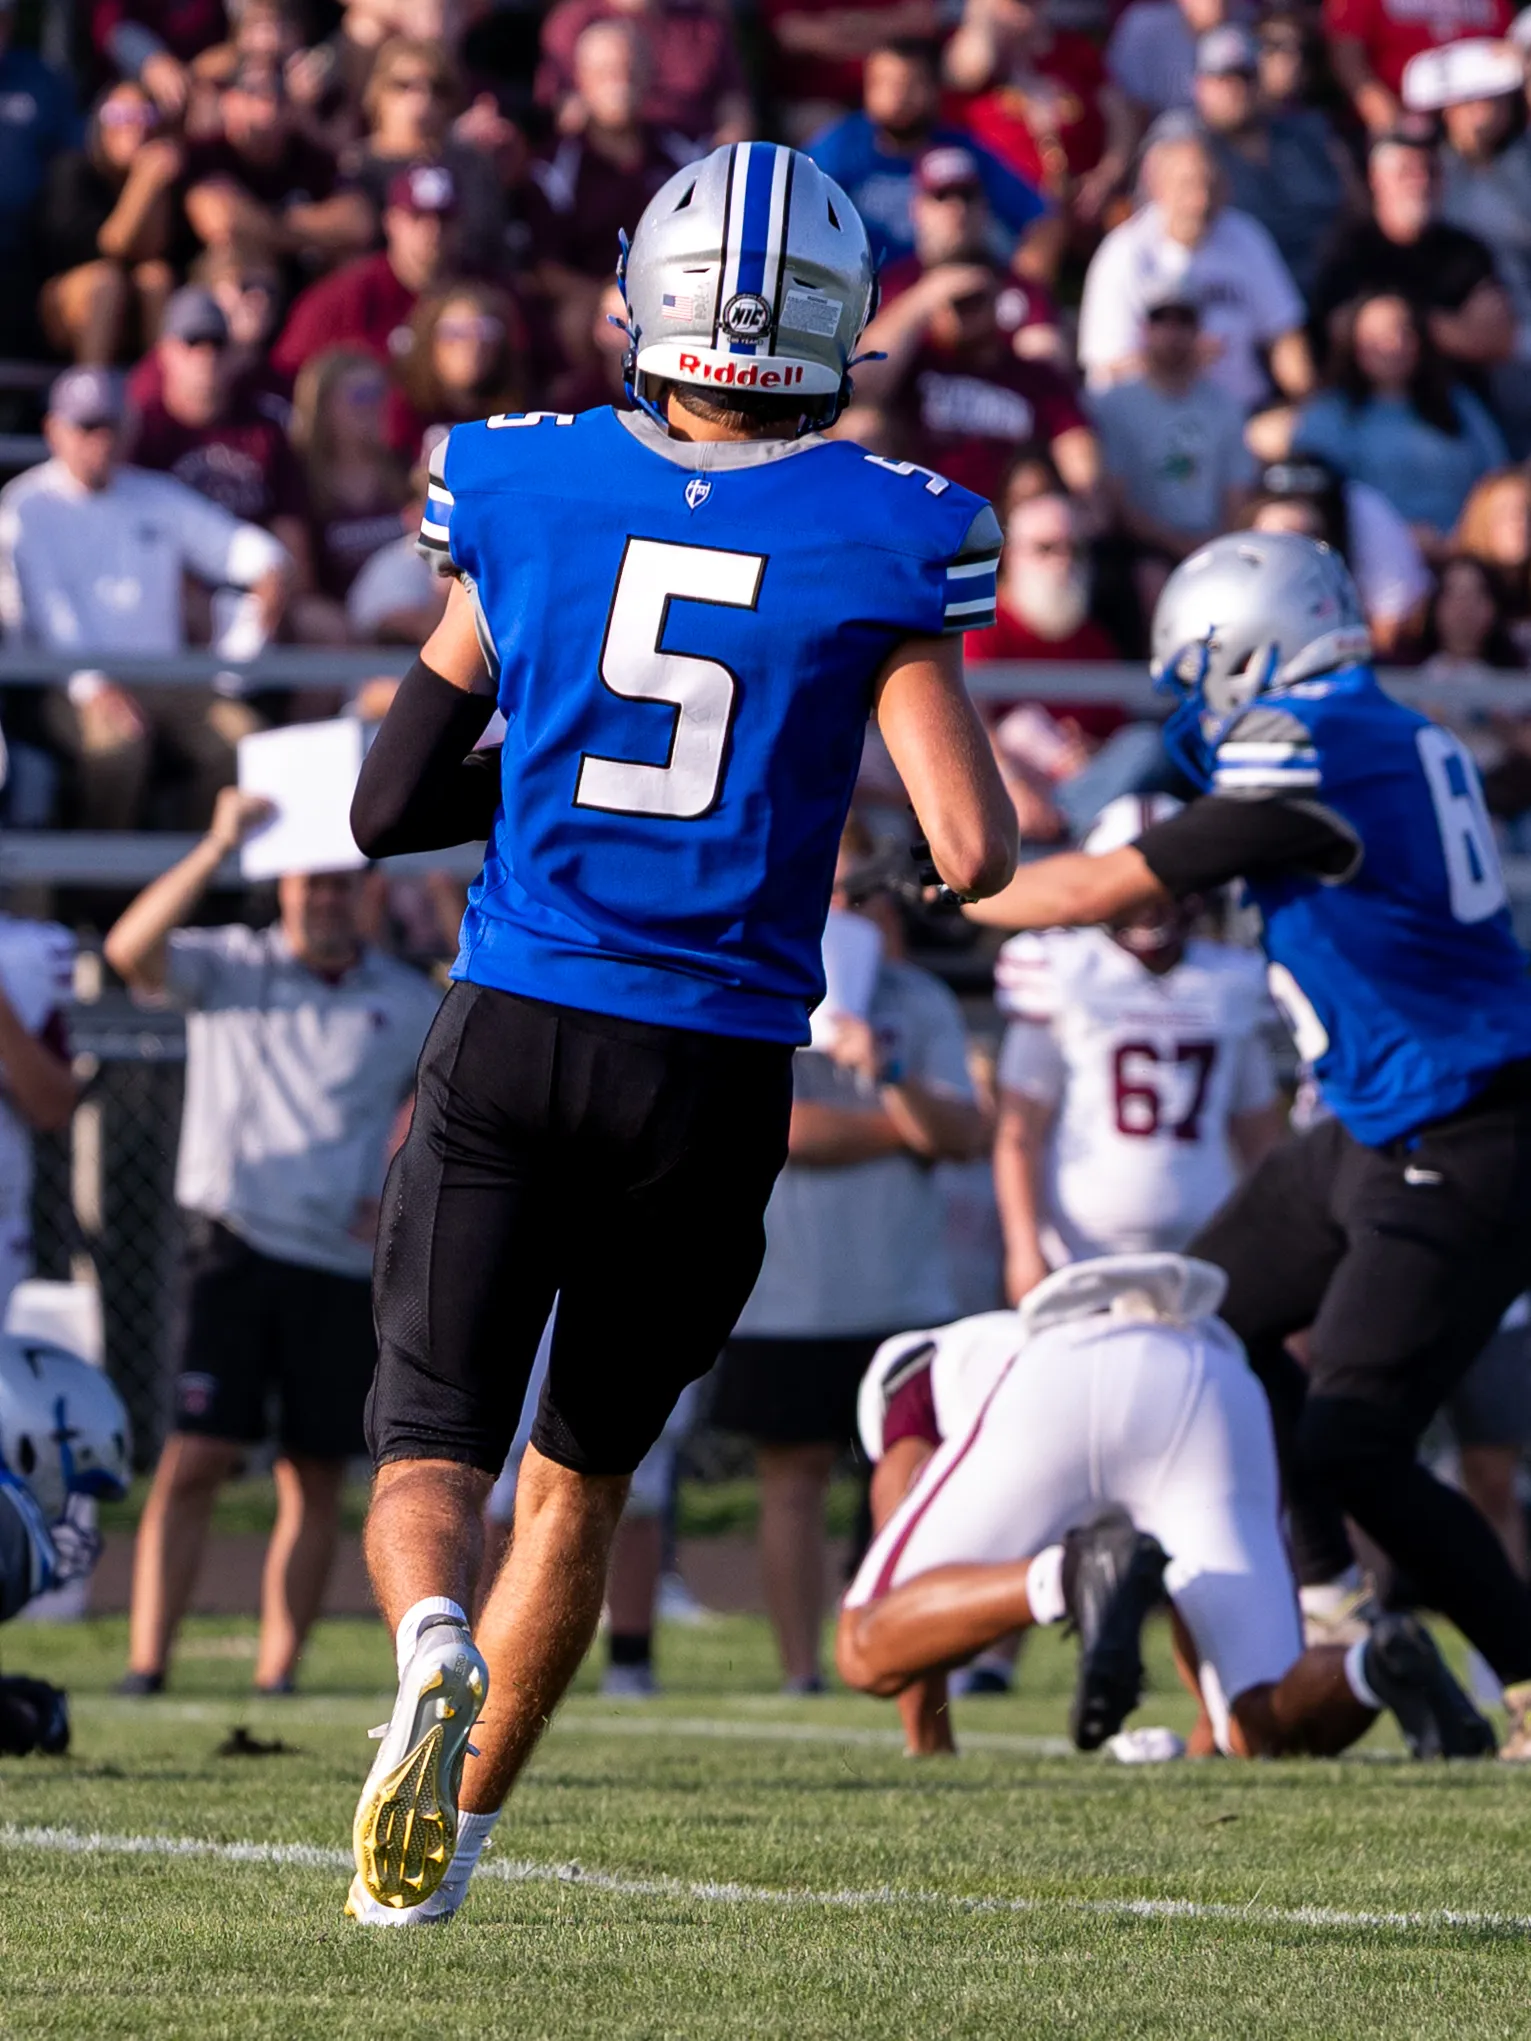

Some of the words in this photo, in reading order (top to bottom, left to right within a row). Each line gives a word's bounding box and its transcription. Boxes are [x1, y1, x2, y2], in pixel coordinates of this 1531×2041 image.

[679, 353, 804, 388] Riddell
[572, 534, 770, 821] 5
[1114, 1037, 1218, 1140] 67
